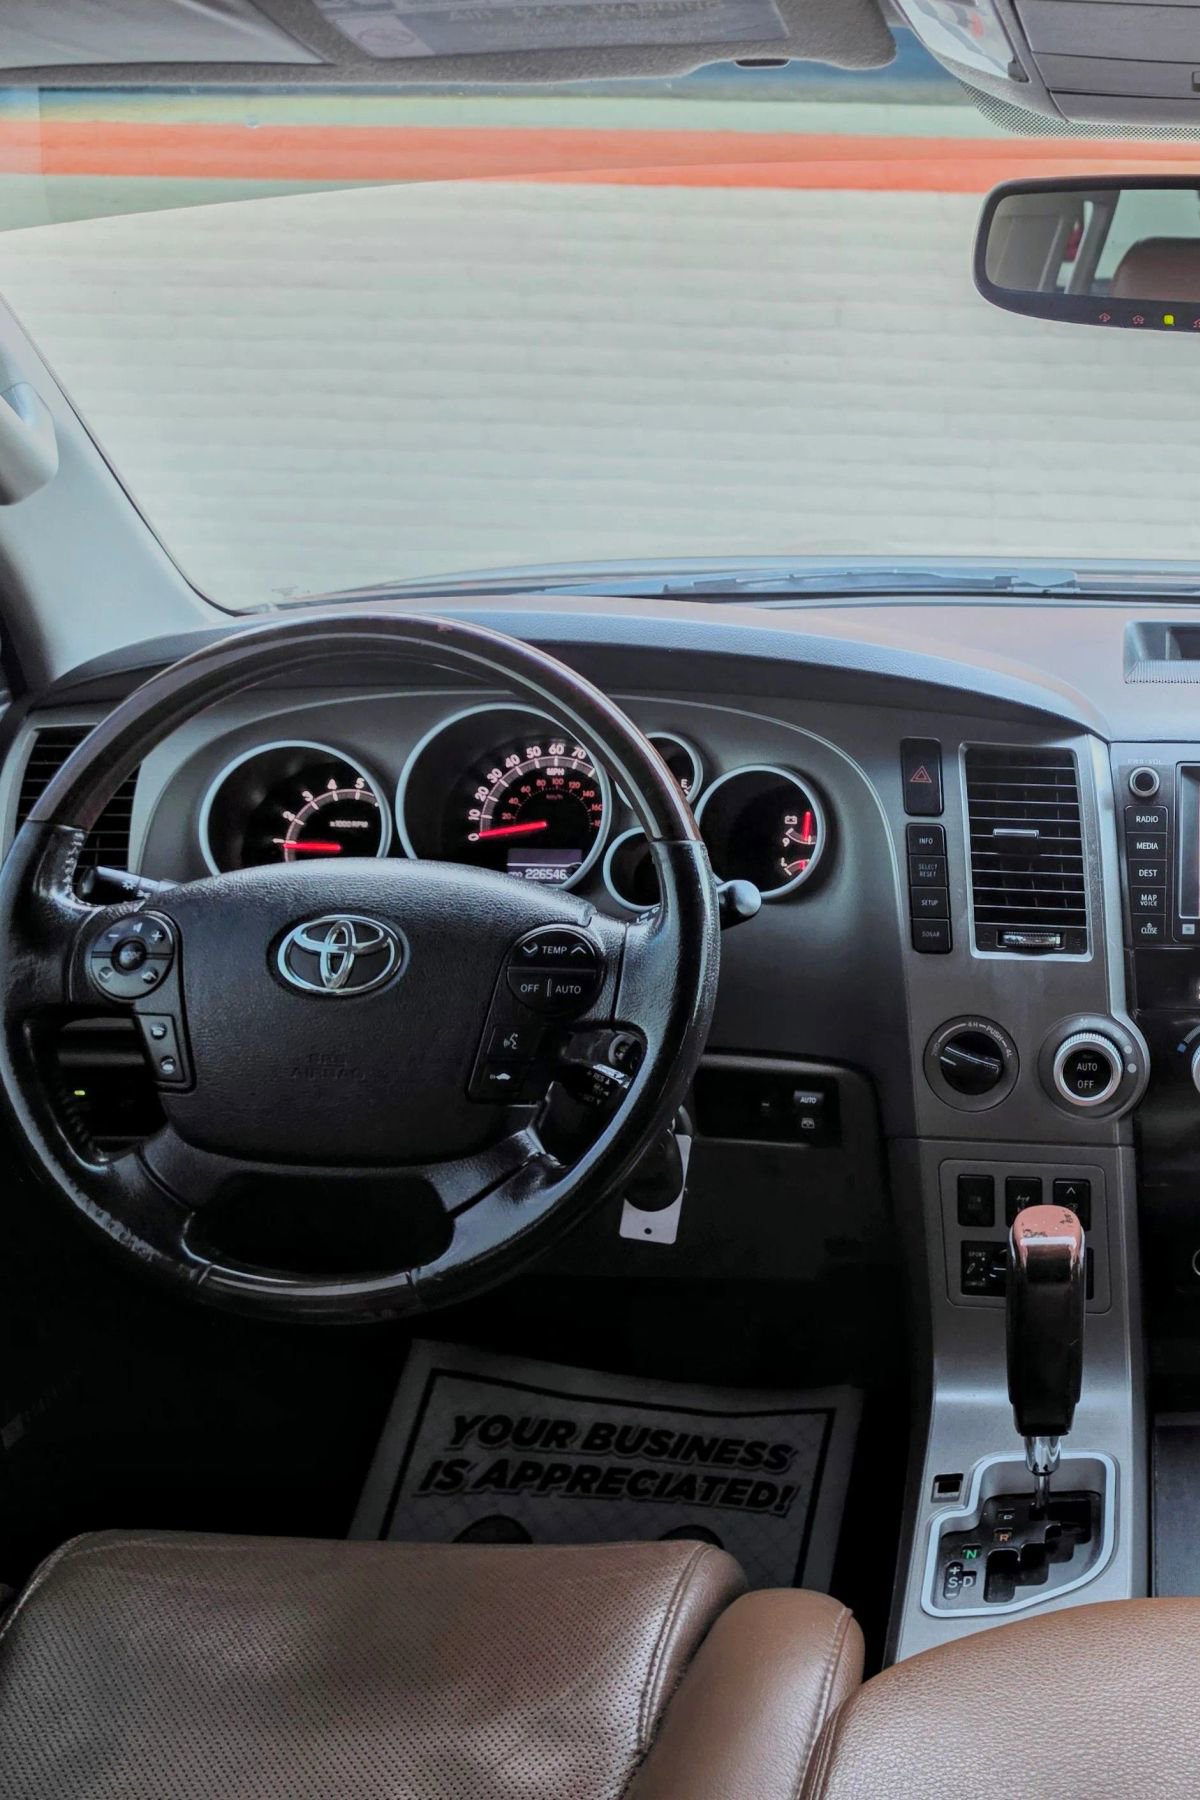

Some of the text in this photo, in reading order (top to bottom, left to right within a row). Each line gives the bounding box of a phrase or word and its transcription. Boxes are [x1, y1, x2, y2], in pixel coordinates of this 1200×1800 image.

[526, 745, 541, 759] 50
[548, 743, 565, 756] 60
[571, 746, 586, 760] 70
[505, 754, 520, 769] 40
[487, 768, 503, 784] 30
[546, 768, 565, 776] MPH
[327, 778, 338, 790] 4
[354, 777, 365, 789] 5
[474, 786, 489, 802] 20
[468, 808, 481, 821] 10
[1136, 815, 1159, 823] RADIO
[919, 837, 934, 845] INFO
[1136, 842, 1158, 850] MEDIA
[525, 868, 567, 880] 226546
[1138, 869, 1158, 877] DEST
[921, 898, 939, 906] SETUP
[1140, 927, 1158, 935] CLOSE
[542, 945, 567, 955] TEMP
[520, 983, 540, 993] OFF
[555, 984, 582, 994] AUTO
[985, 1025, 1004, 1042] PUSH
[1076, 1062, 1098, 1072] AUTO
[1077, 1079, 1095, 1089] OFF
[800, 1096, 817, 1104] AUTO
[451, 1414, 798, 1471] YOUR BUSINESS
[417, 1458, 797, 1513] IS APPRECIATED!
[1000, 1532, 1010, 1542] R
[965, 1549, 978, 1559] N
